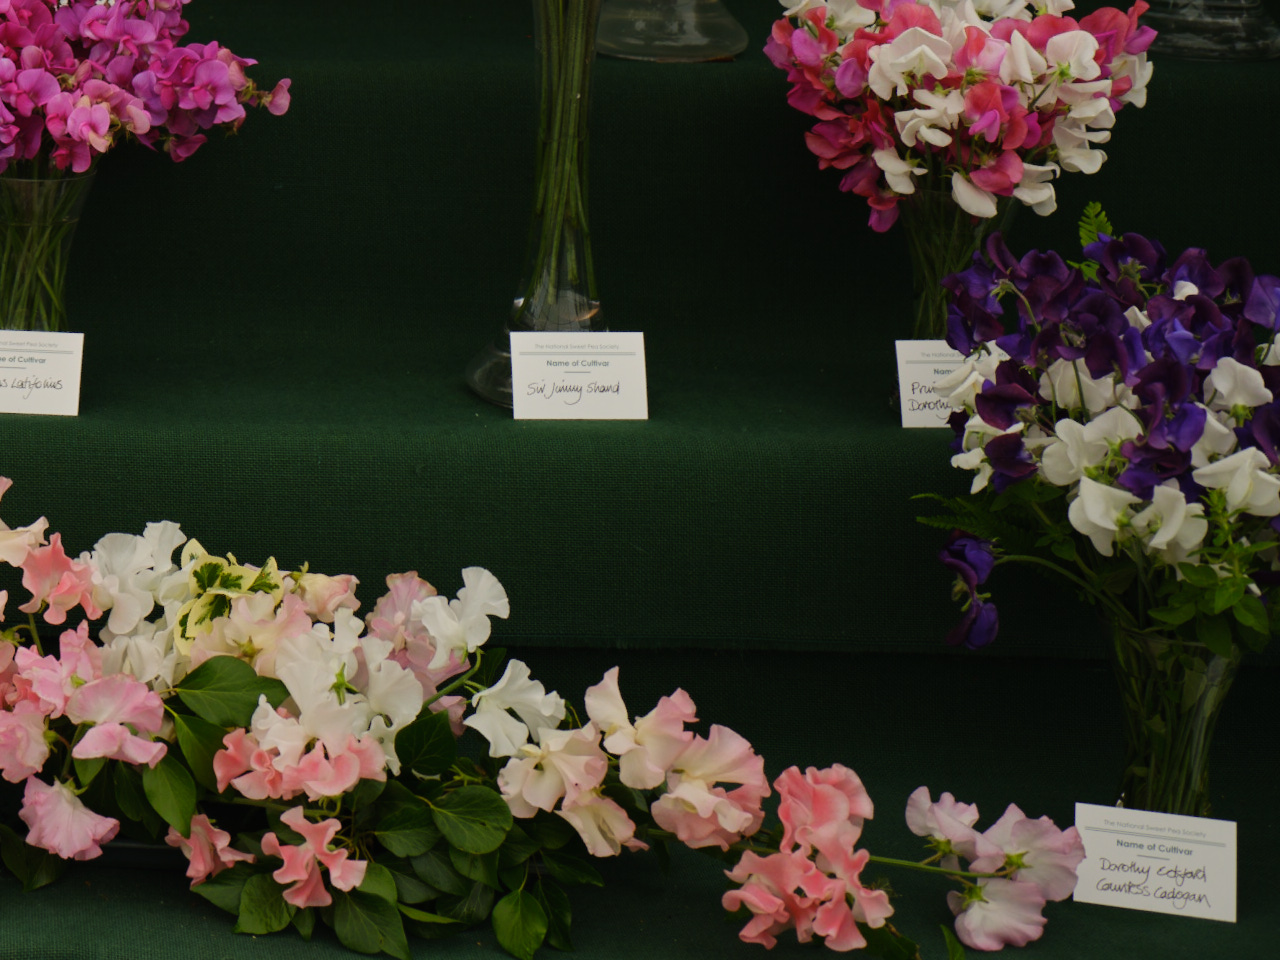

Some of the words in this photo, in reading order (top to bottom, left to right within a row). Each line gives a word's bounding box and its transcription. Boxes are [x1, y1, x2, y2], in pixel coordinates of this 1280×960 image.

[18, 356, 46, 364] Cultivar
[527, 379, 545, 395] Sir
[544, 379, 583, 405] Jimmy
[587, 381, 620, 394] Shand
[1117, 820, 1144, 830] National
[1182, 828, 1206, 838] Society
[1116, 840, 1144, 850] Name
[1147, 843, 1156, 851] of
[1159, 844, 1193, 856] Cultivar
[1100, 857, 1150, 885] Dorothy
[1154, 886, 1211, 909] Cadogan
